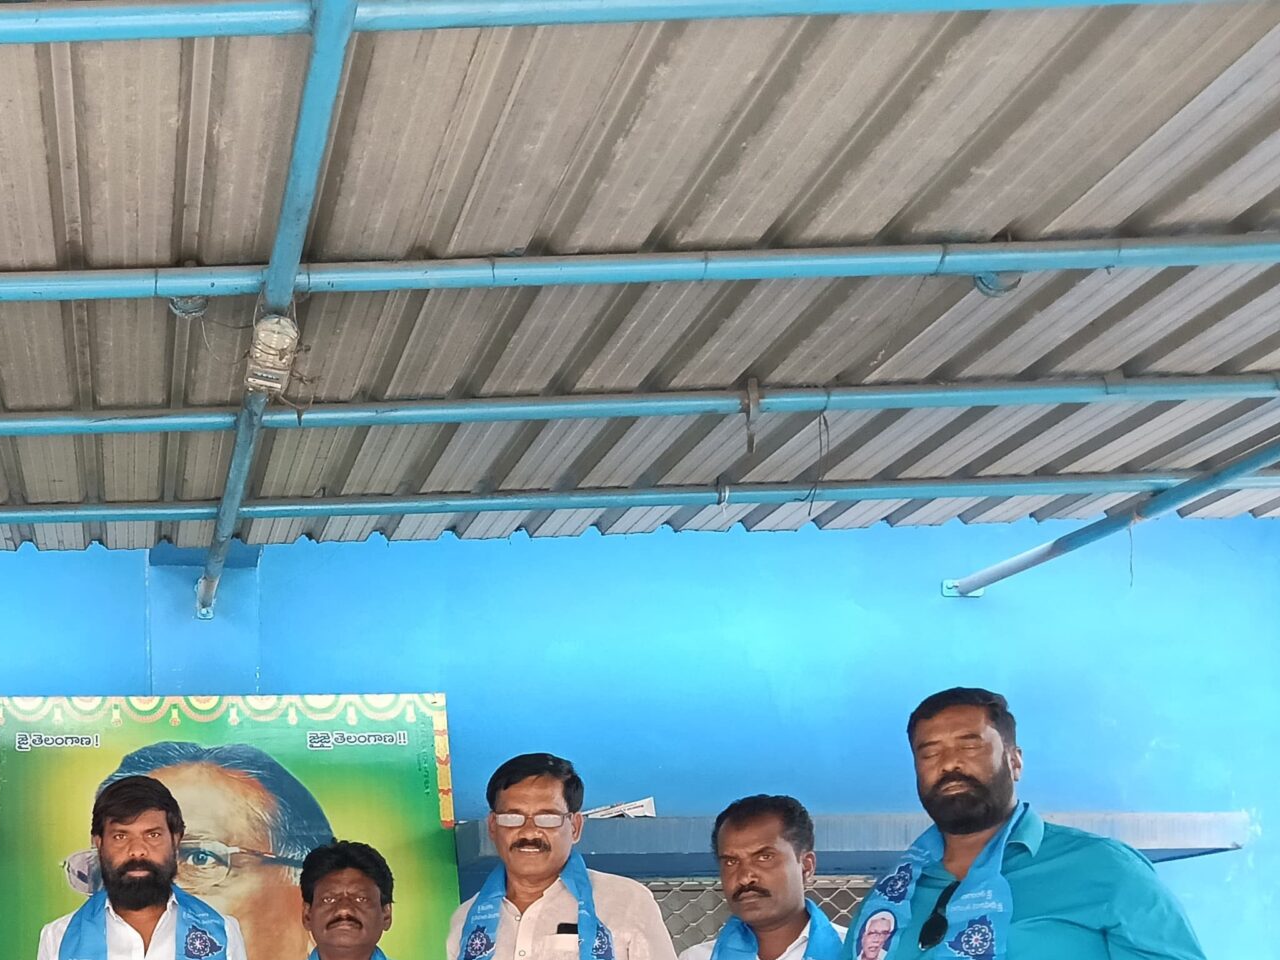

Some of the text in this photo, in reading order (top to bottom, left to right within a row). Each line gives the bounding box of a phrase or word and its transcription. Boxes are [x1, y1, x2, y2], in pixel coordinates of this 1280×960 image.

[17, 733, 30, 750] జై
[31, 734, 92, 746] తెలంగాణ
[334, 732, 395, 745] తెలంగాణ
